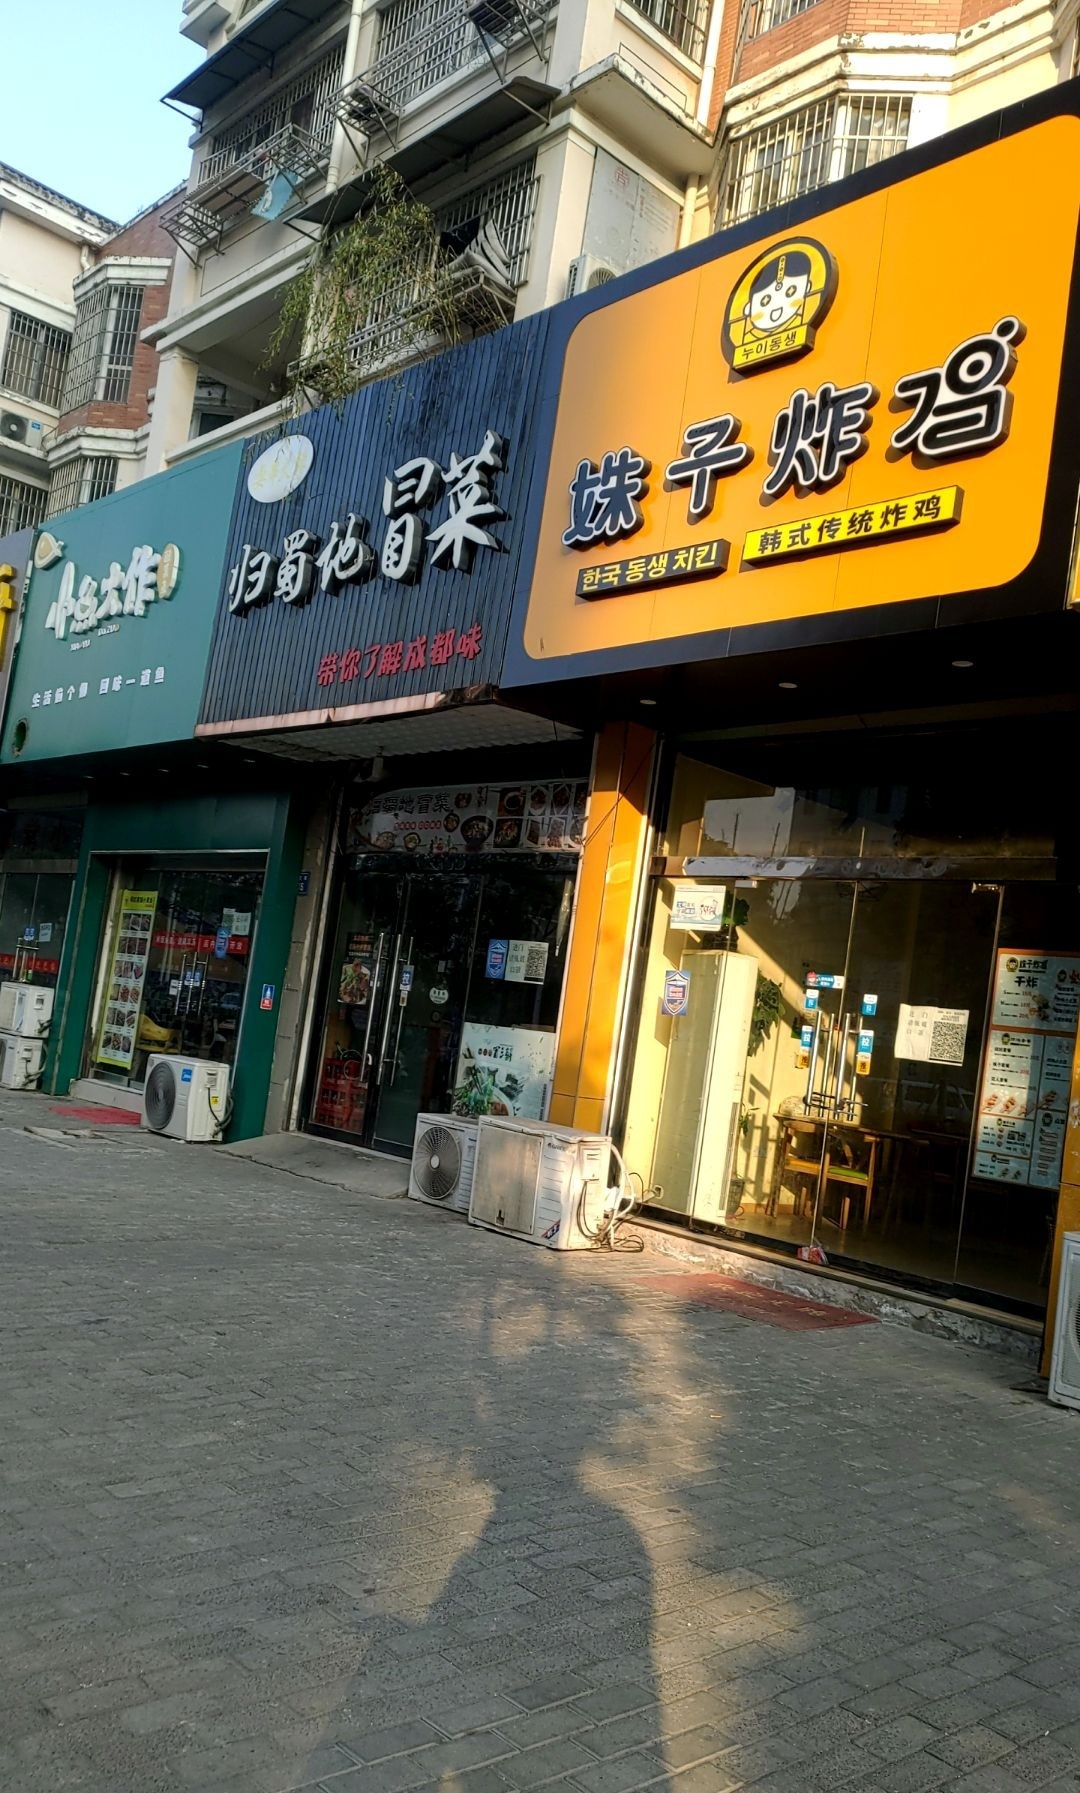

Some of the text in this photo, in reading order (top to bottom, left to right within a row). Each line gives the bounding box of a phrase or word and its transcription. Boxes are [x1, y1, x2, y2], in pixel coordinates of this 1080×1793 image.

[742, 331, 797, 360] 누이동생
[758, 495, 942, 554] 韩式传统炸鸡
[582, 542, 718, 591] 한국 동생 치킨
[317, 622, 483, 686] 带你了解成都味
